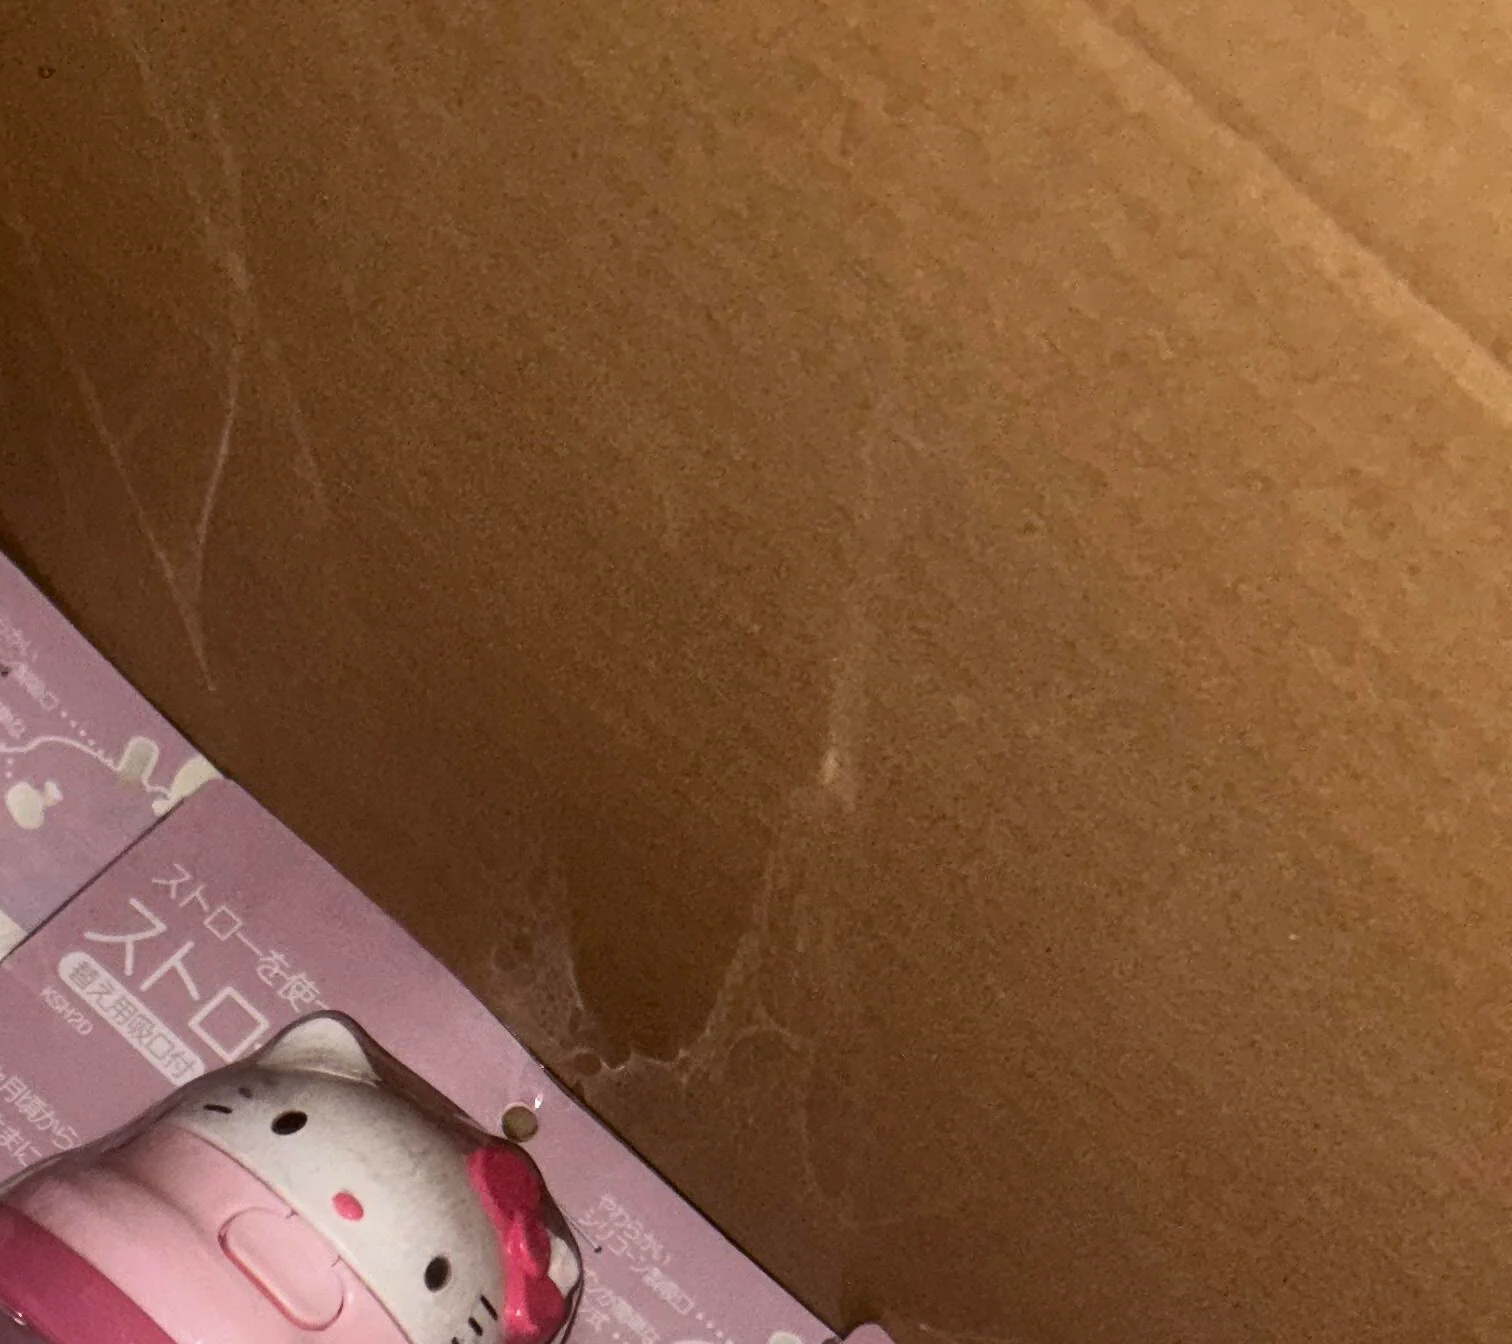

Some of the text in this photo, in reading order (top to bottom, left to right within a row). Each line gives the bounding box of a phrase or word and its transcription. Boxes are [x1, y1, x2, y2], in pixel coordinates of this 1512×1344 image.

[83, 898, 270, 1063] ストロ
[151, 863, 330, 1013] ストローを使
